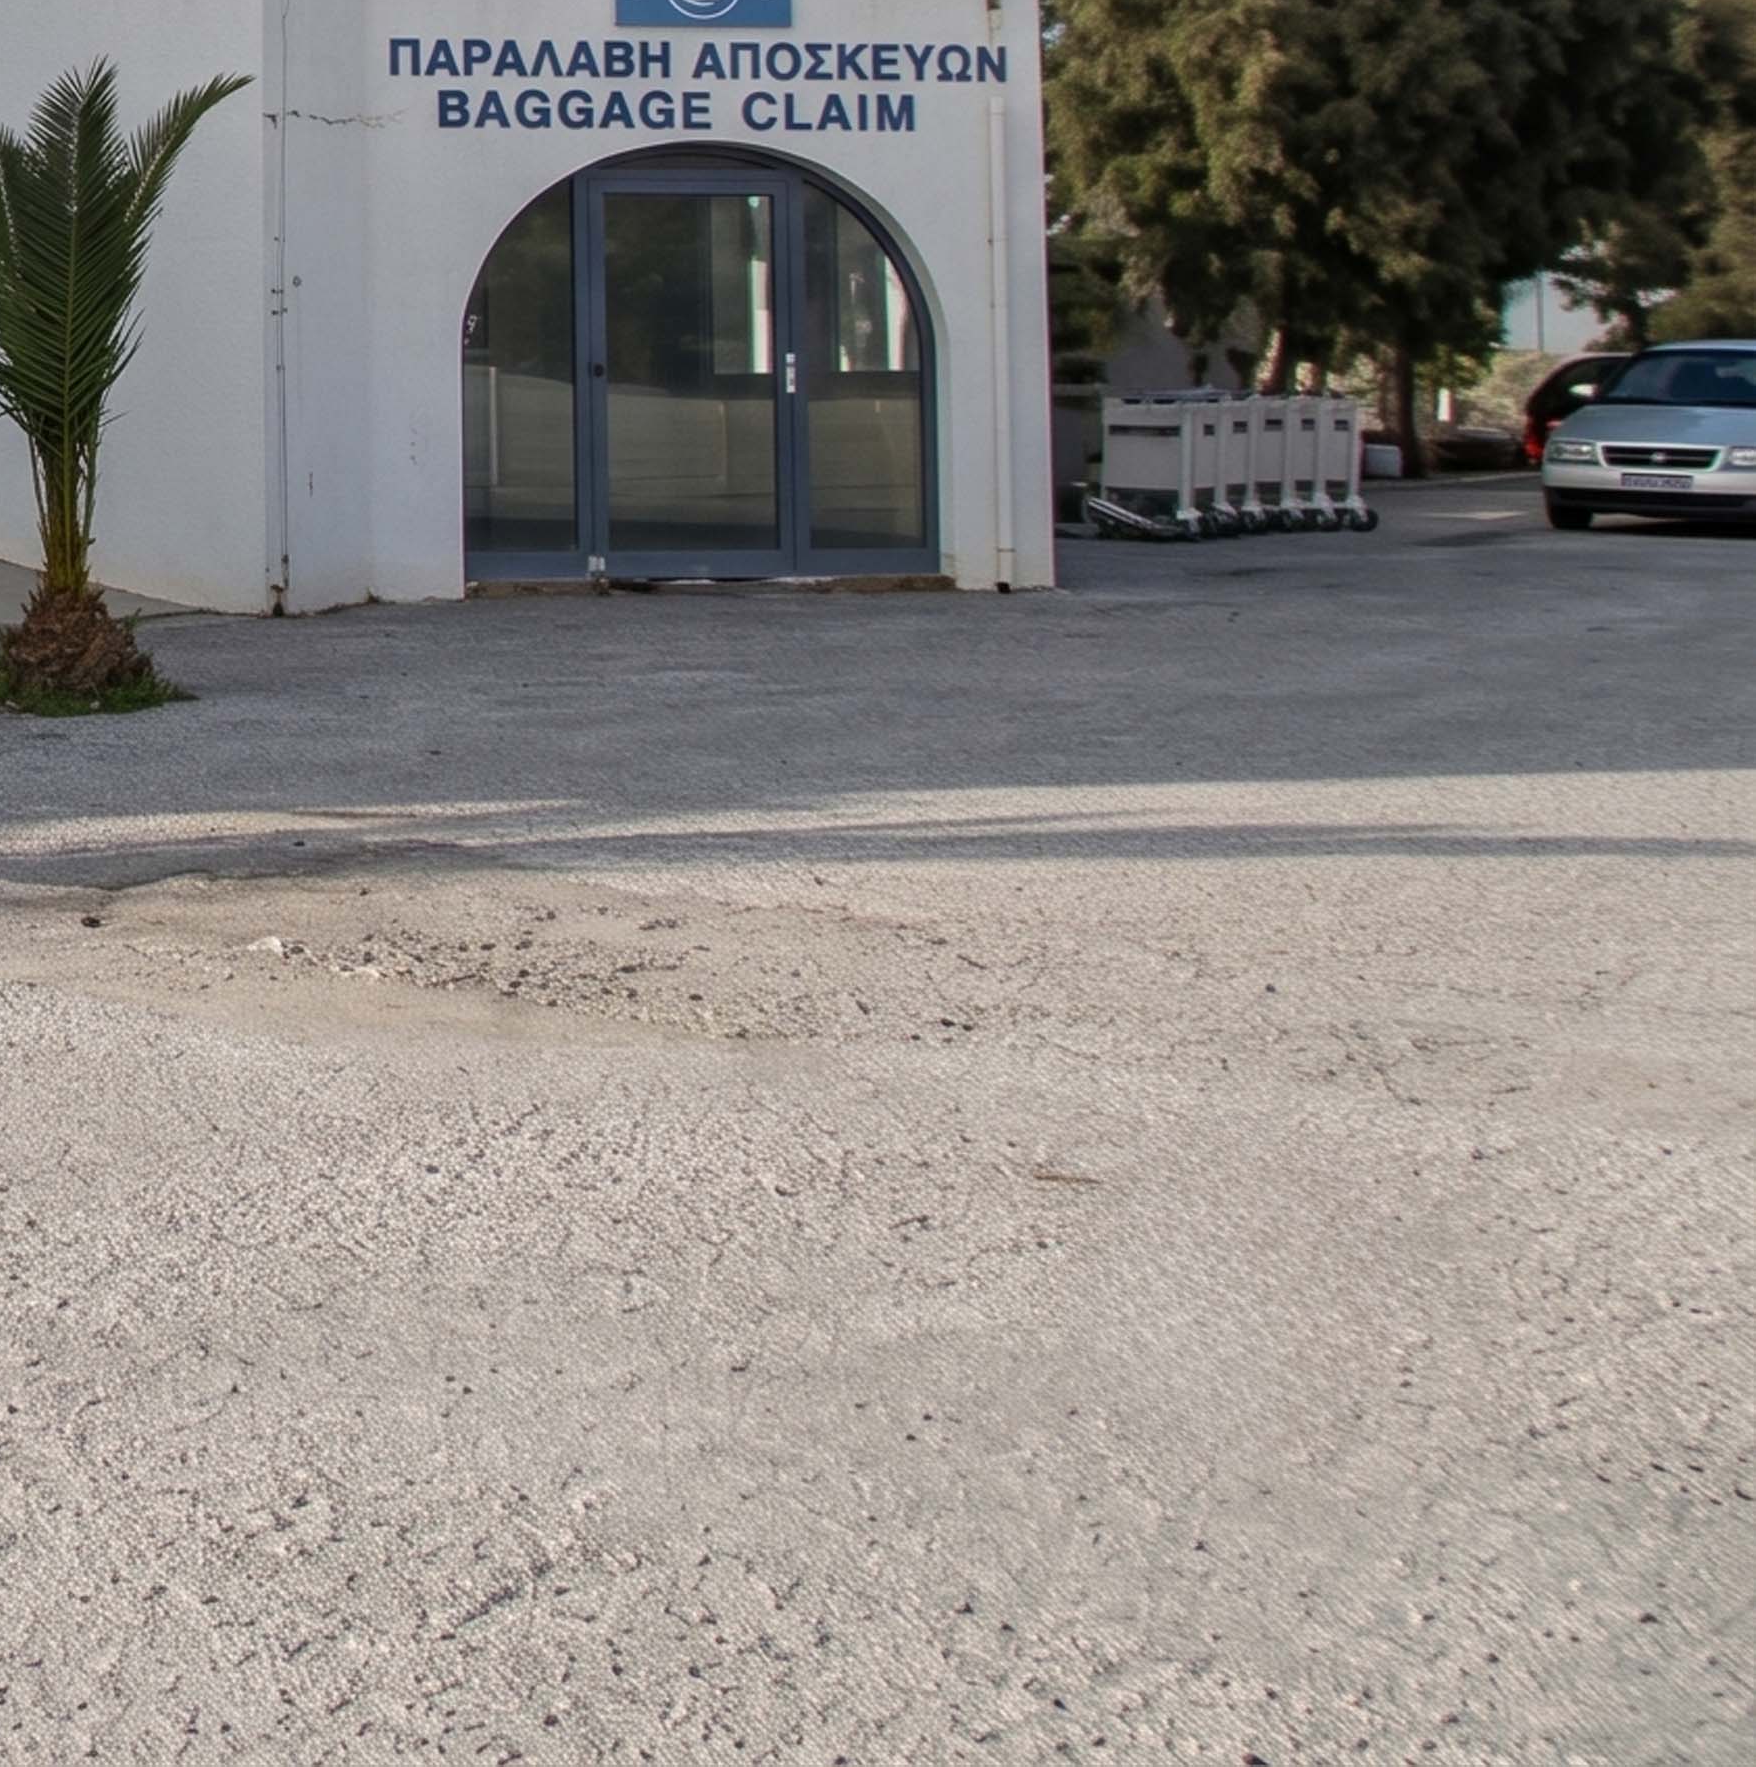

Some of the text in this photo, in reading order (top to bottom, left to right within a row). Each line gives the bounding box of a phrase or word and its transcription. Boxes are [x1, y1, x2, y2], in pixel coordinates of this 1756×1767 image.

[389, 37, 1008, 83] ΠΑΡΑΛΑΒΗ ΑΠΟΣΚΕΥΩΝ
[437, 88, 917, 133] BAGGAGE CLAIM
